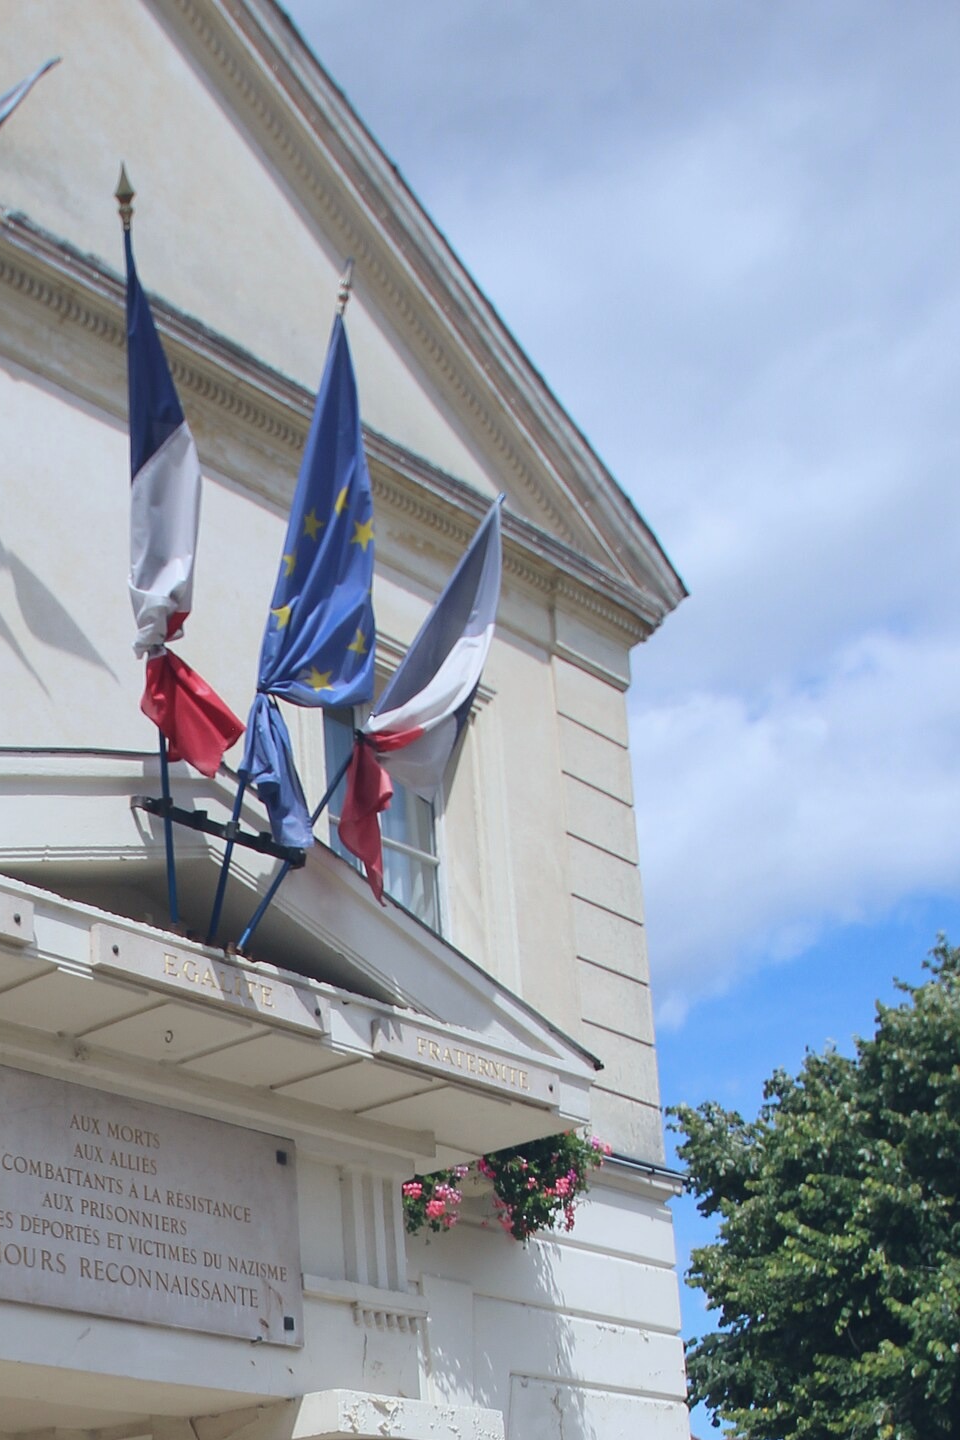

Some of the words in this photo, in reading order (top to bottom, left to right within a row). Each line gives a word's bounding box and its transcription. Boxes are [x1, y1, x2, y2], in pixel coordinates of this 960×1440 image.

[163, 952, 275, 1009] EGALITE
[416, 1036, 530, 1091] FRATERNITE
[69, 1113, 101, 1136] AUX
[107, 1121, 161, 1150] MORTS
[73, 1142, 104, 1164] AUX
[1, 1153, 124, 1195] COMBATTANTS
[143, 1184, 162, 1204] LA
[42, 1192, 74, 1213] AUX
[80, 1198, 188, 1236] PRISONNIERS
[79, 1255, 259, 1309] RECONNAISSANTE
[107, 1231, 124, 1251] ET
[128, 1235, 197, 1265] VICTIMES
[203, 1250, 222, 1270] DU
[227, 1255, 288, 1283] NAZISME
